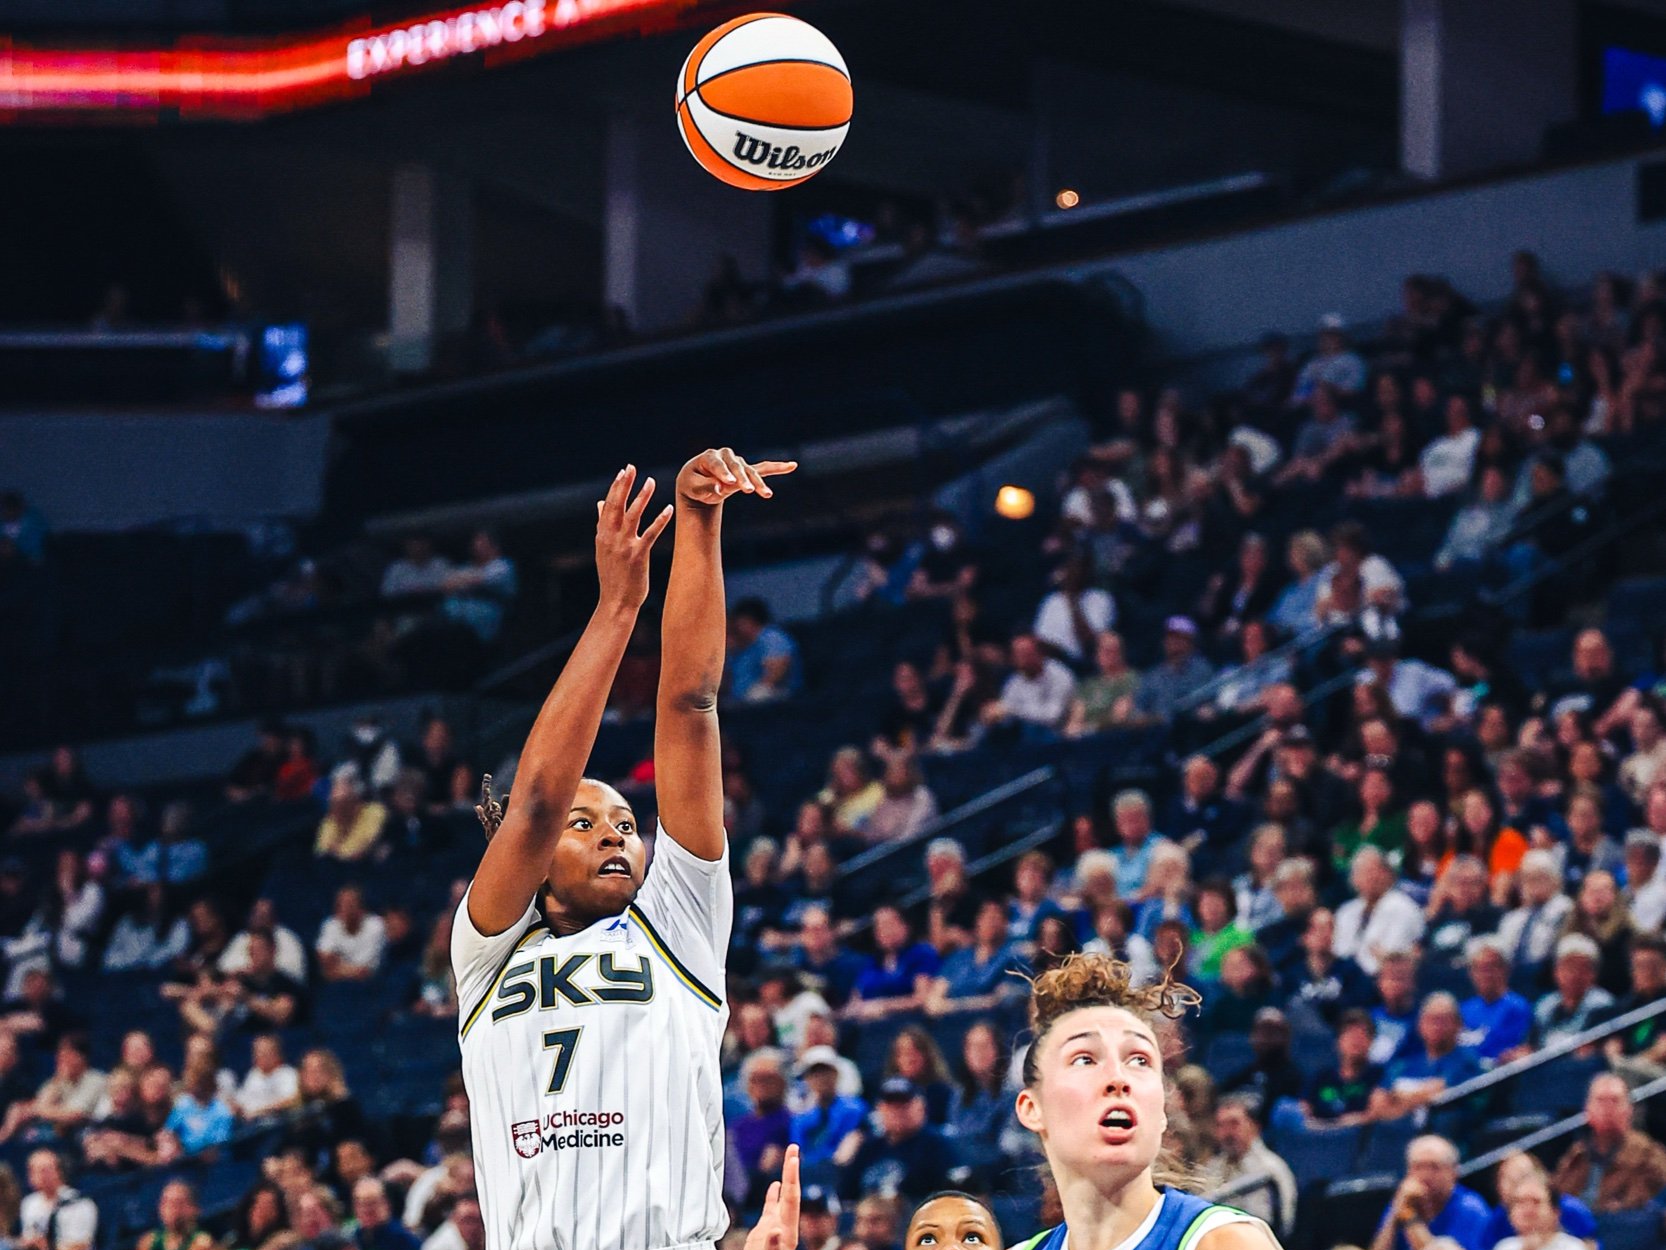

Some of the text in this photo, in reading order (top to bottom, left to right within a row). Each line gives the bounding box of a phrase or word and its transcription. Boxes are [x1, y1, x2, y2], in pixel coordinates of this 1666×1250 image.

[733, 130, 837, 170] Wilson
[492, 951, 656, 1025] SKY
[541, 1025, 585, 1097] 7
[540, 1129, 624, 1153] Medicine
